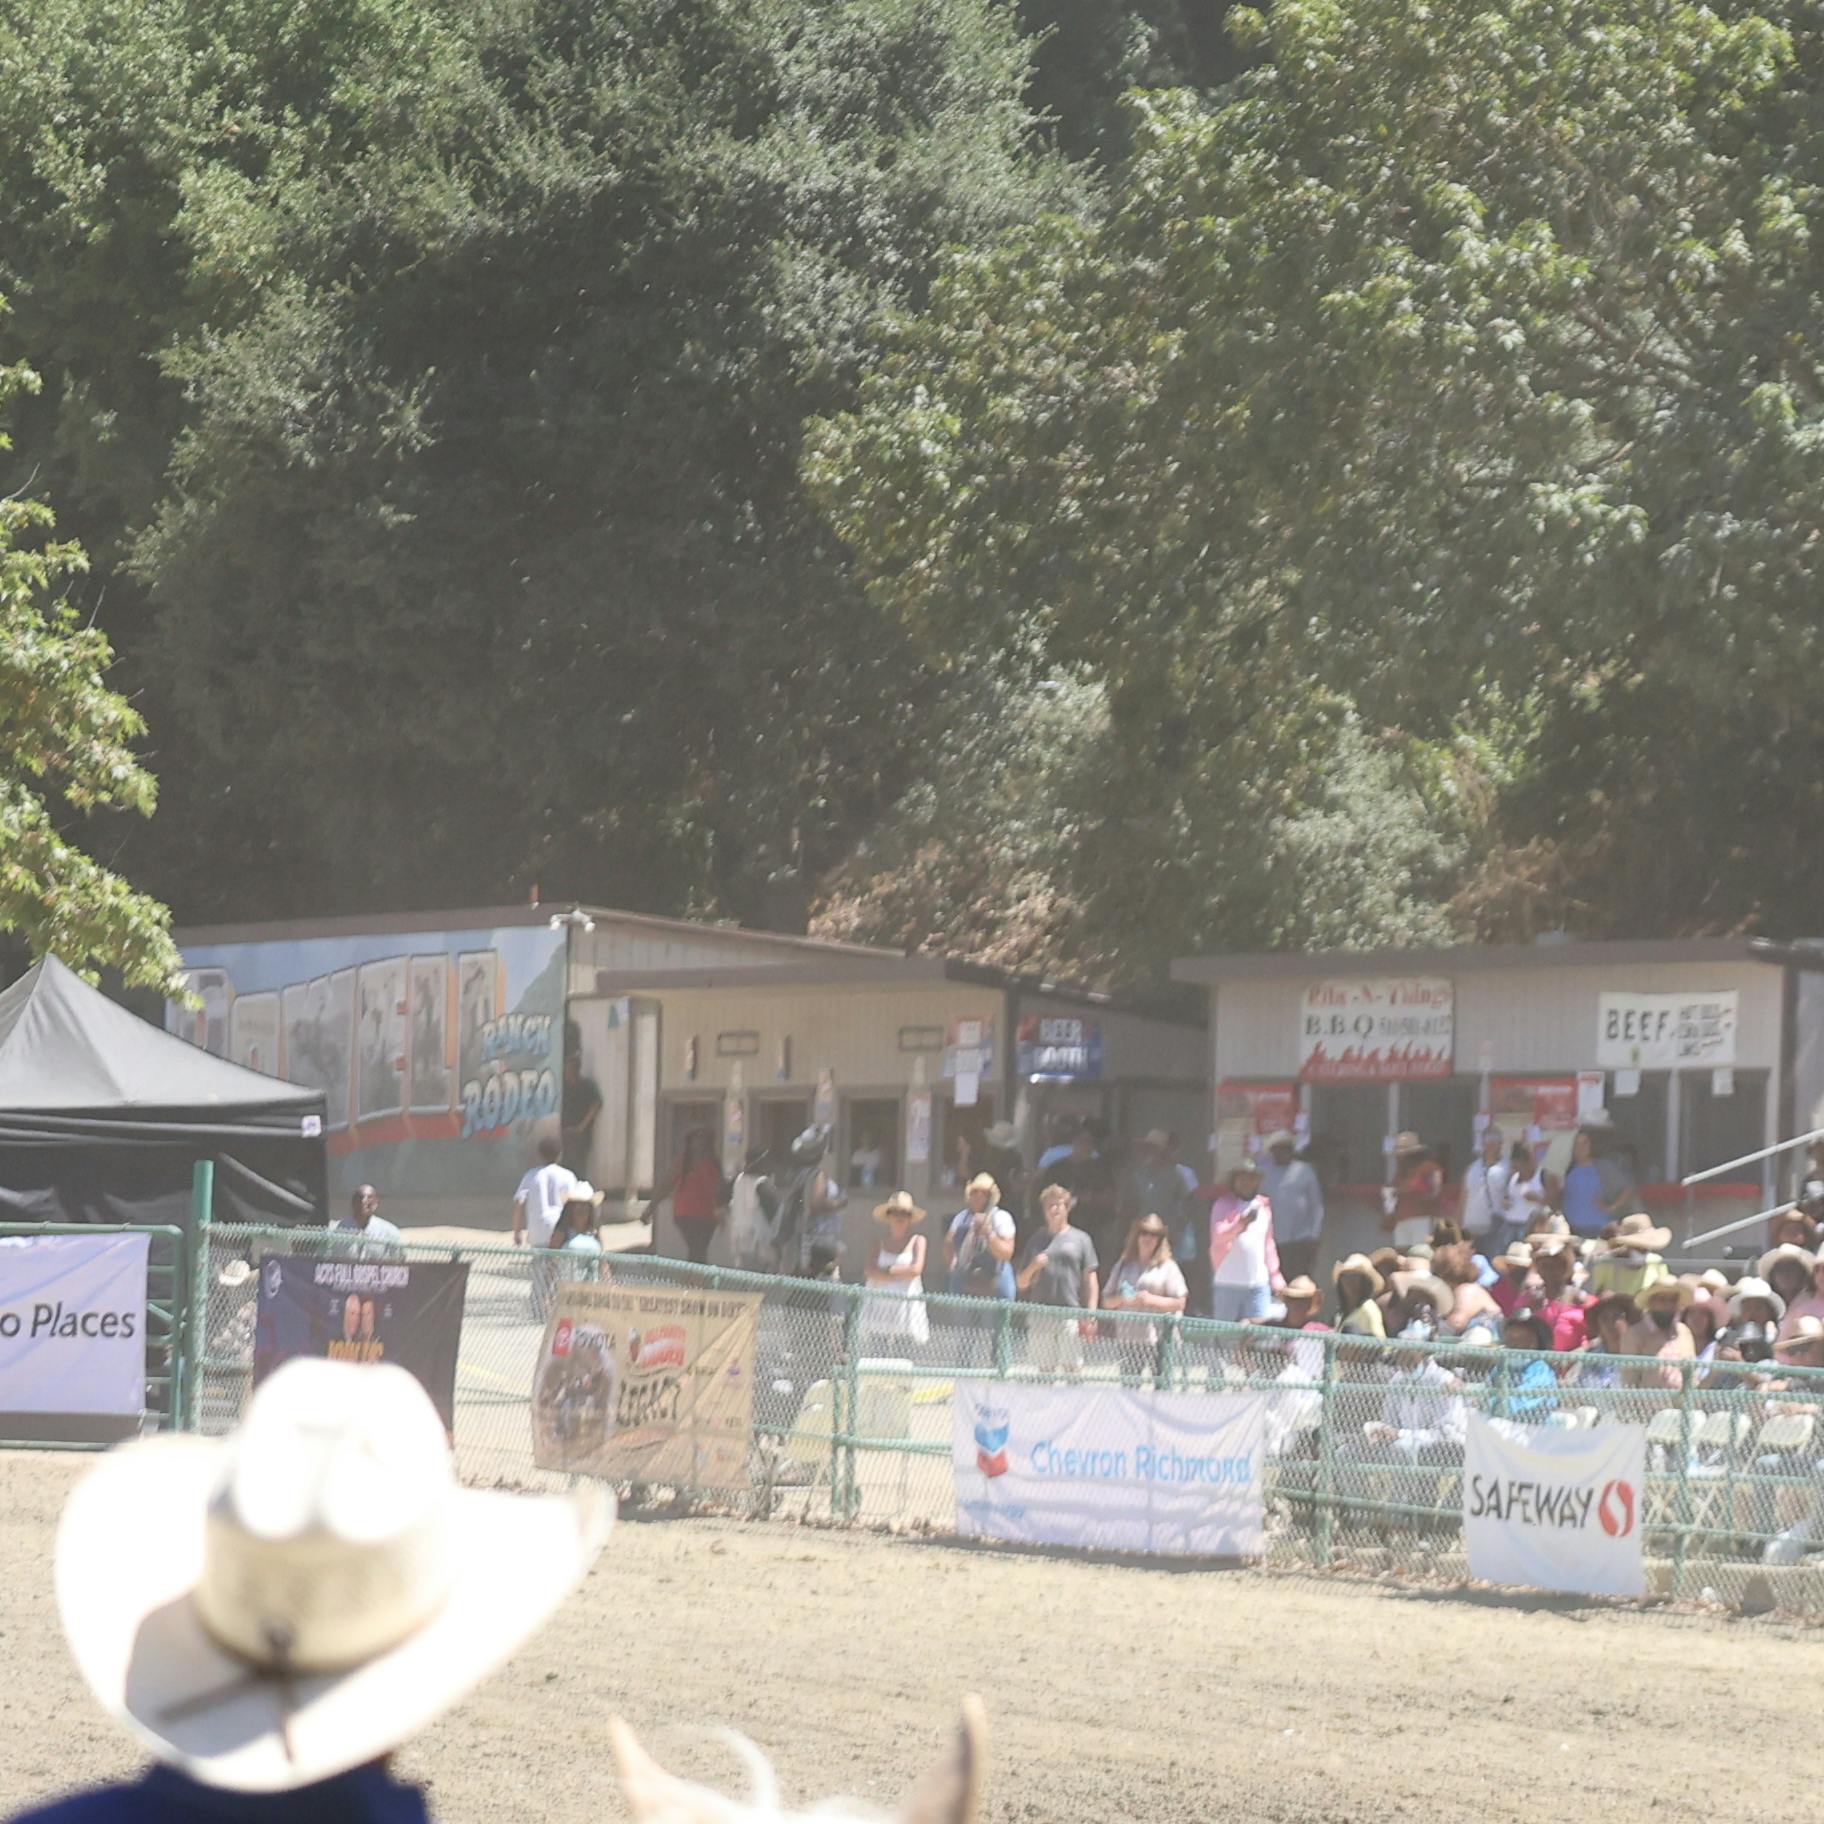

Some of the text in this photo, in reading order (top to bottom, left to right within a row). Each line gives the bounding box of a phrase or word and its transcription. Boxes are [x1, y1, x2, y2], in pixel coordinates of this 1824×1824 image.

[482, 1012, 552, 1061] RANCH
[1039, 1018, 1083, 1042] BEER
[462, 1068, 558, 1139] RODEO
[30, 1302, 136, 1339] Places
[573, 1329, 617, 1350] TOYOTA
[1030, 1439, 1252, 1485] Chevron Richmond
[1470, 1473, 1595, 1529] SAFEWAY
